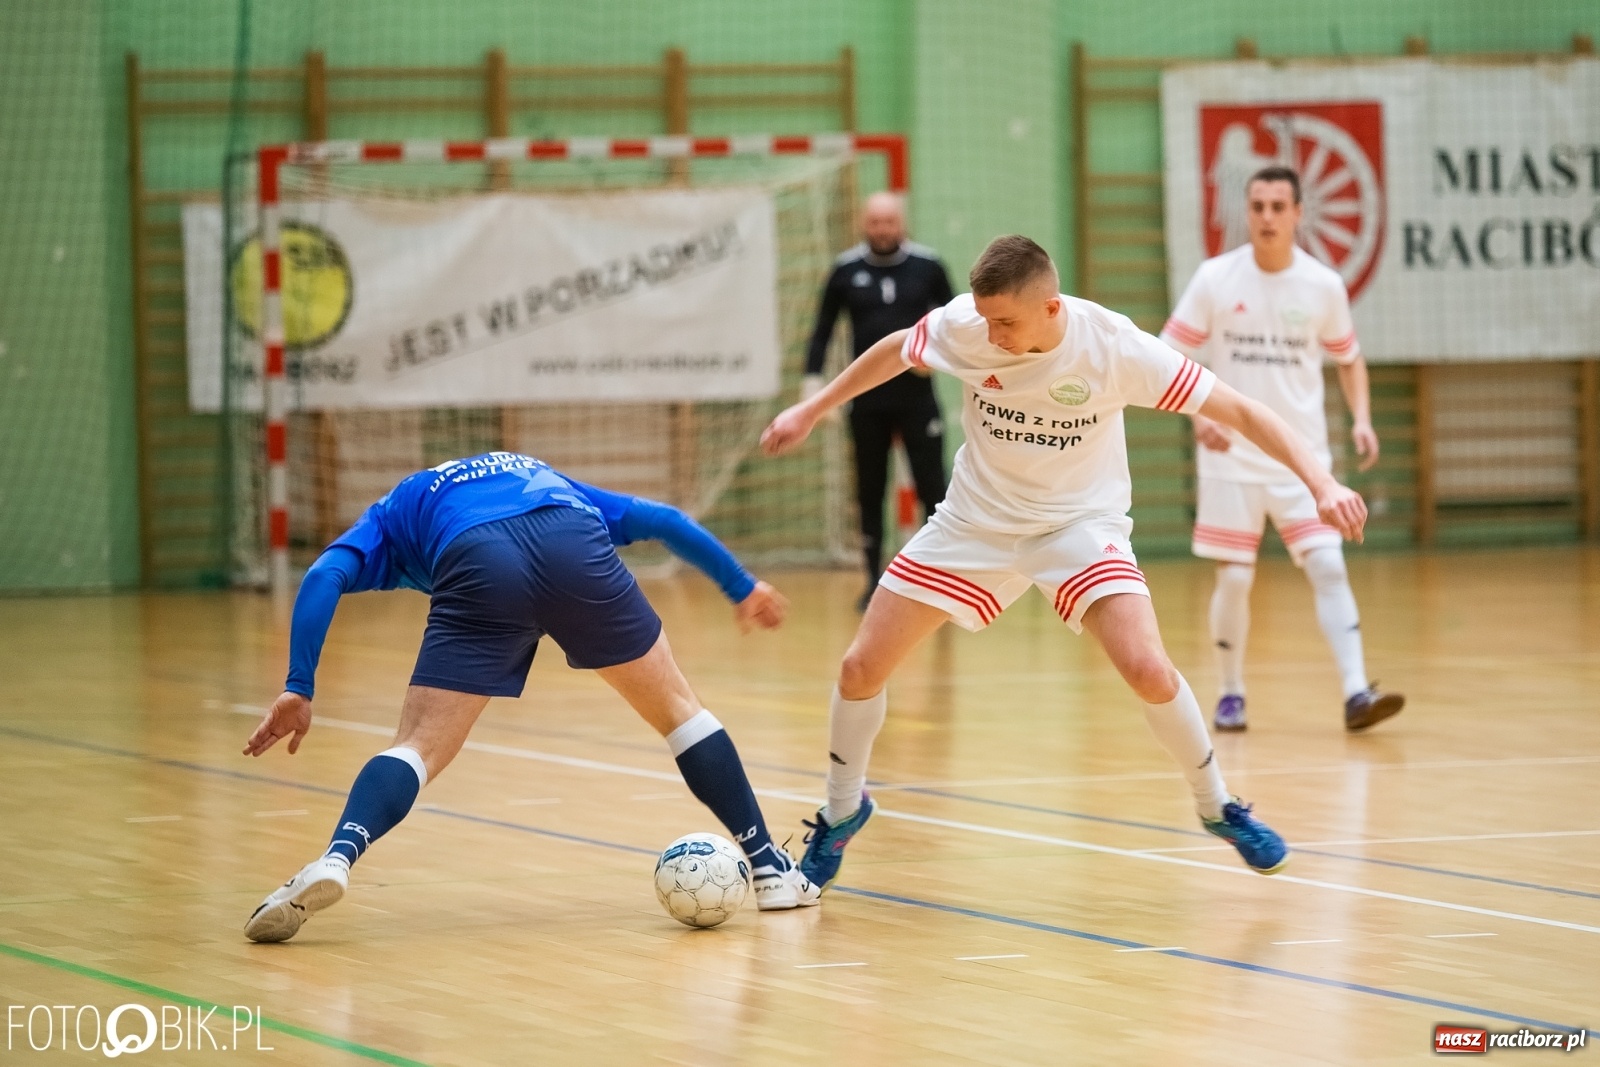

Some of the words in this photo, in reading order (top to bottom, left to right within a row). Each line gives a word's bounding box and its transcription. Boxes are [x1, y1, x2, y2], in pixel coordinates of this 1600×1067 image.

[384, 311, 469, 373] JEST
[479, 293, 519, 336] W
[1033, 416, 1044, 426] z
